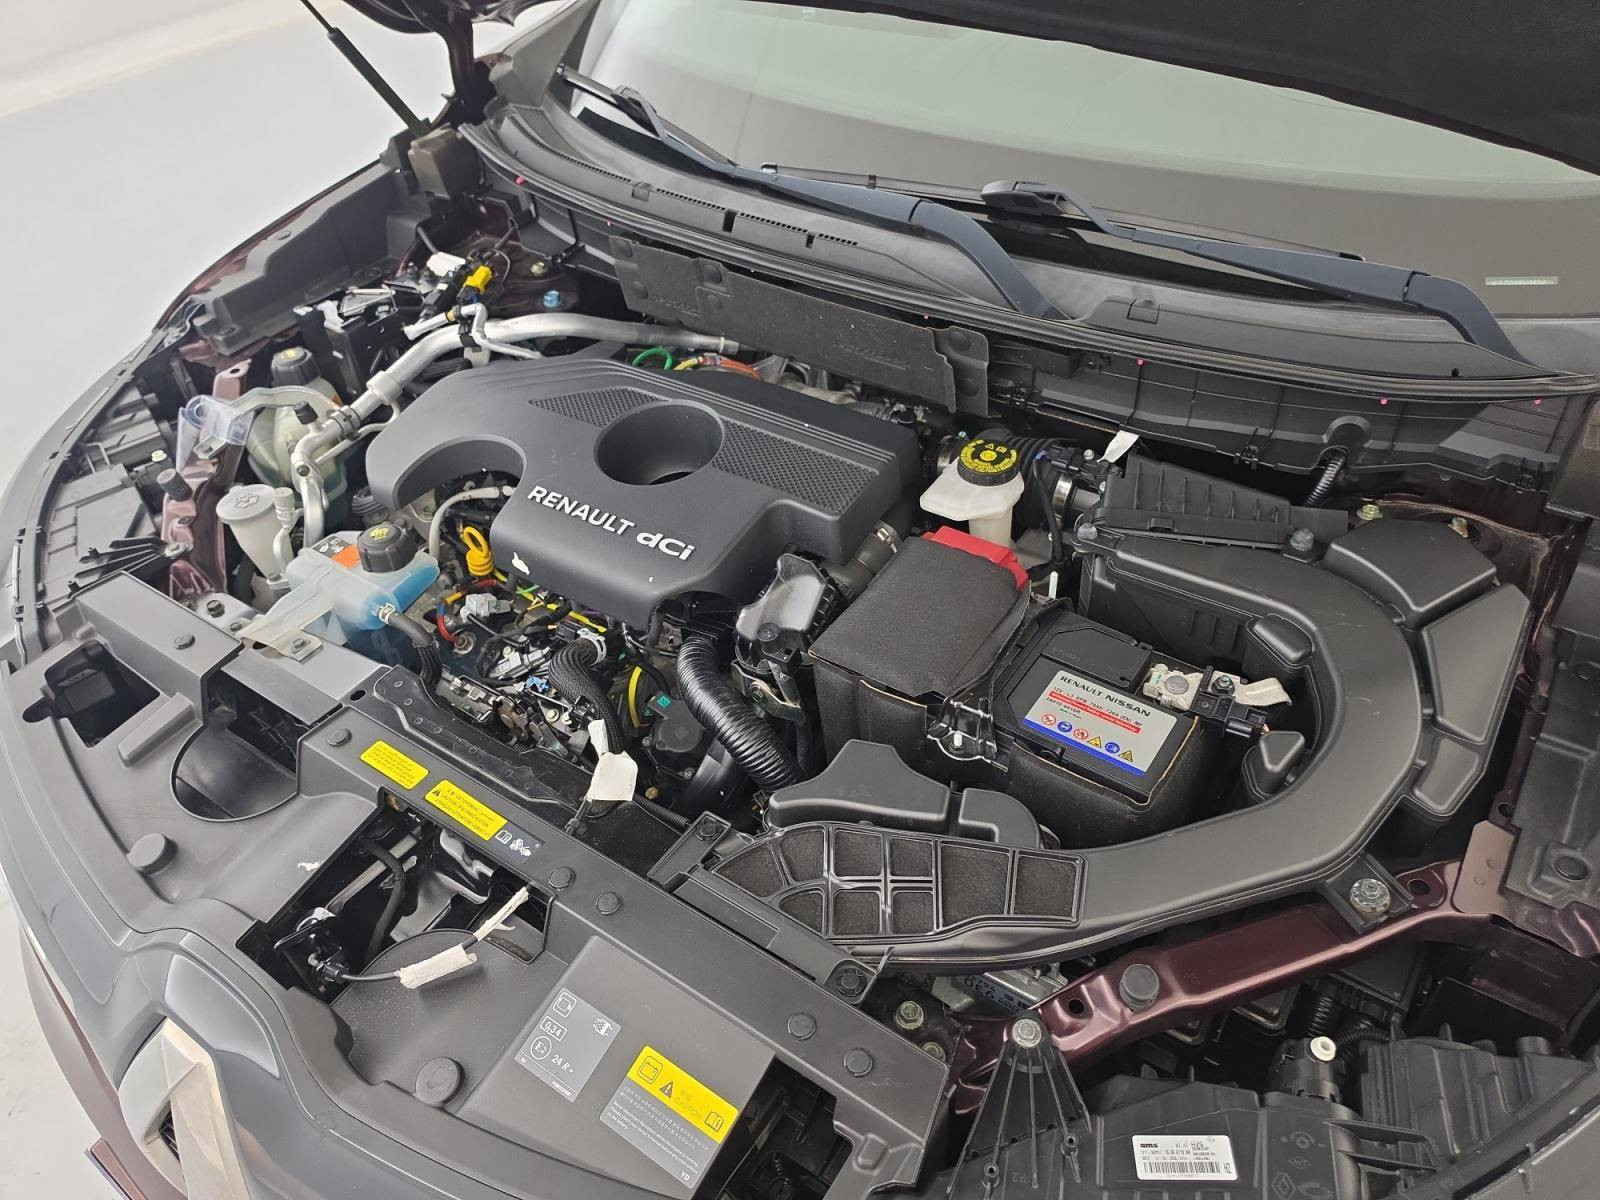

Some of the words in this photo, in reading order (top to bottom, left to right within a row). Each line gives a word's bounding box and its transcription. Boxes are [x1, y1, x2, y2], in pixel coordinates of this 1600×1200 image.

[527, 485, 635, 536] RENAULT
[636, 531, 696, 561] dCi
[1060, 675, 1103, 697] RENAULT
[1105, 694, 1151, 717] NISSAN
[681, 1171, 690, 1181] YD
